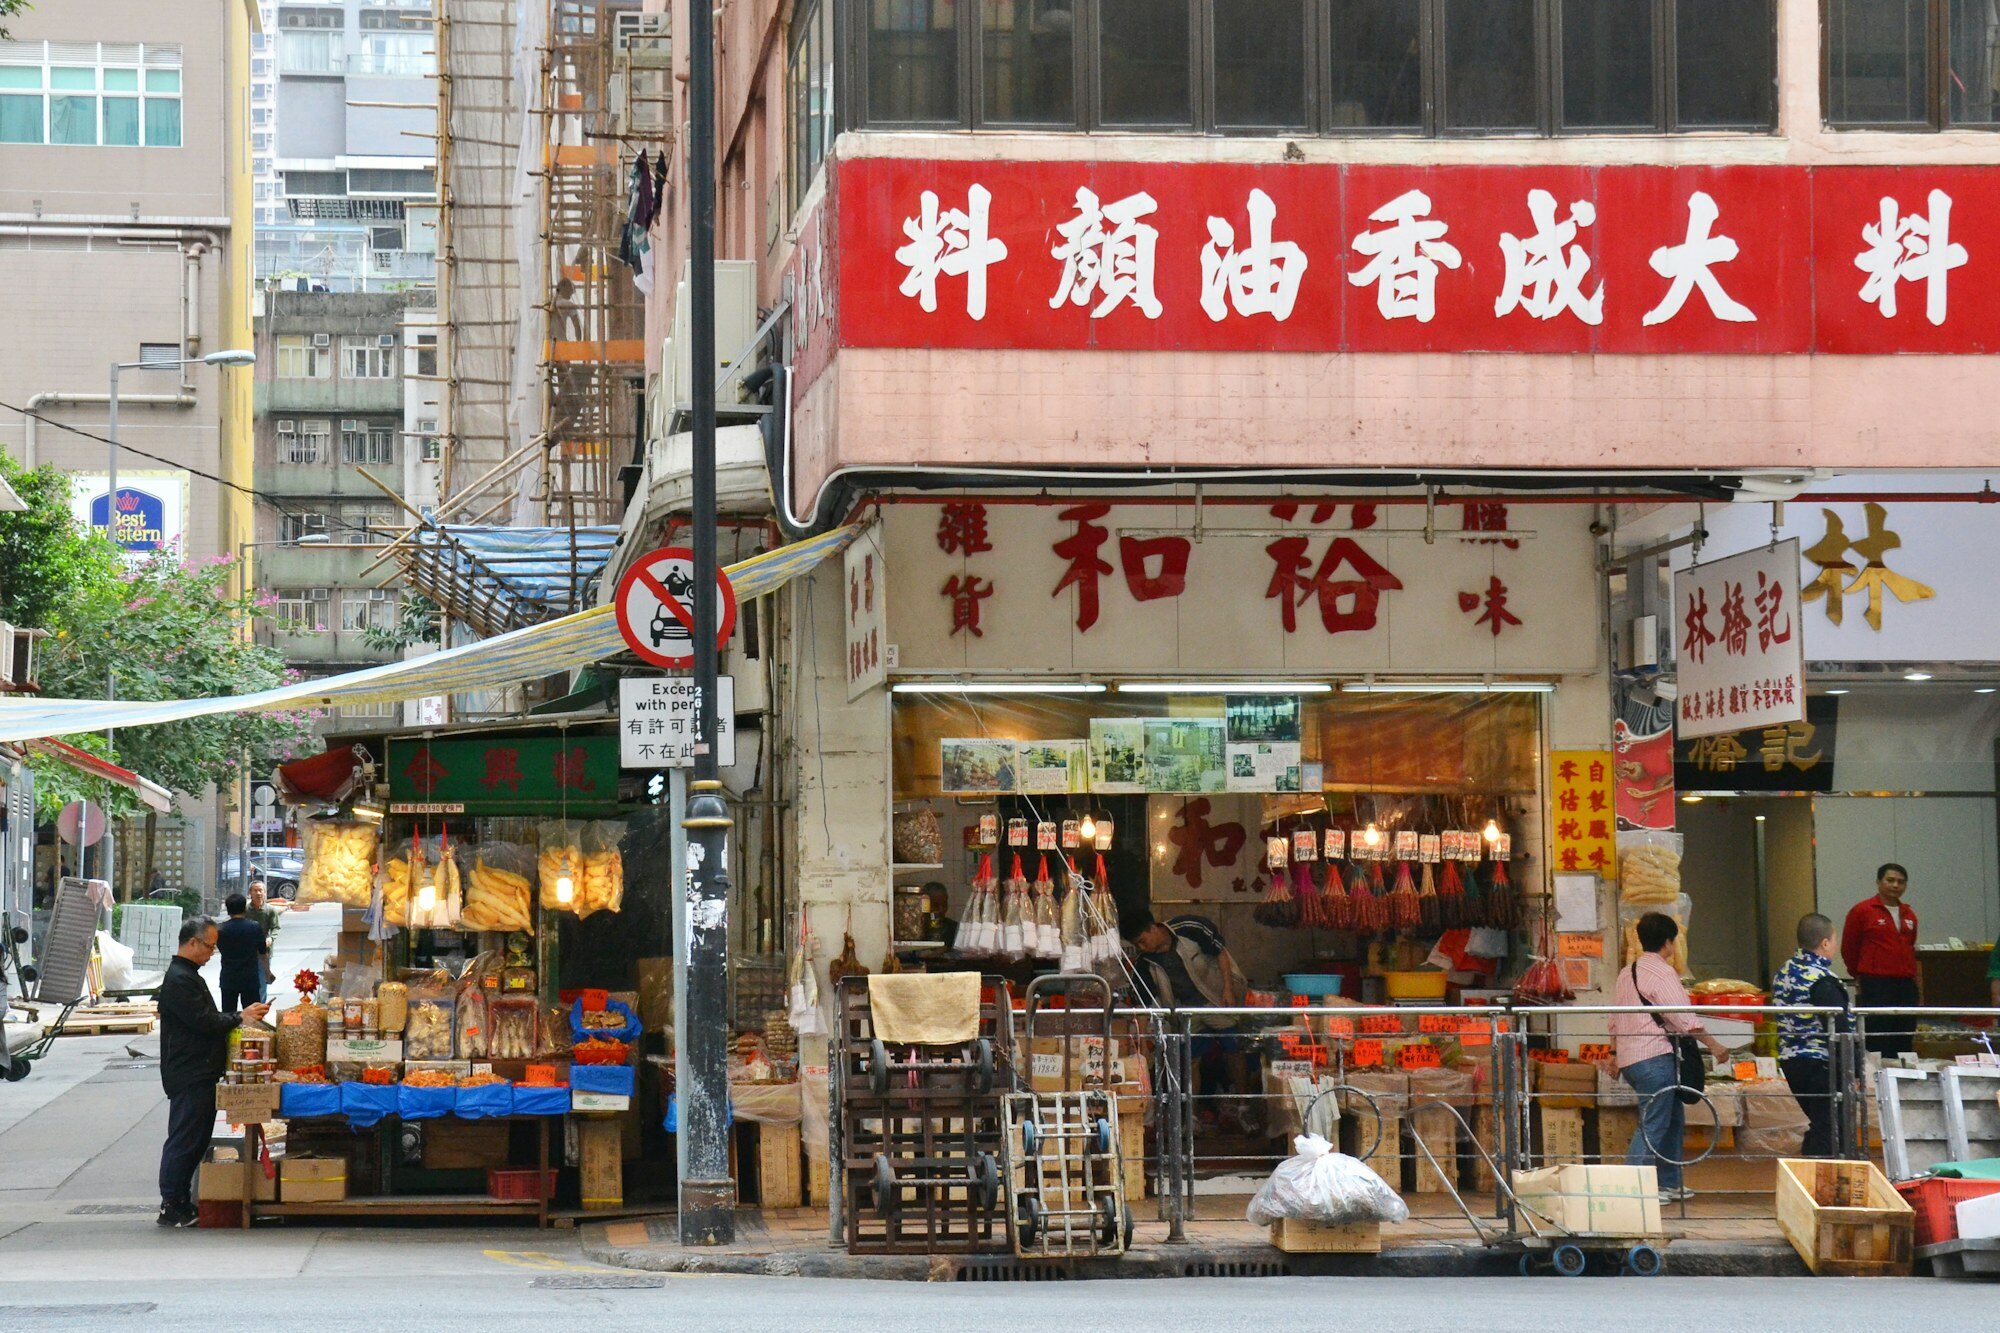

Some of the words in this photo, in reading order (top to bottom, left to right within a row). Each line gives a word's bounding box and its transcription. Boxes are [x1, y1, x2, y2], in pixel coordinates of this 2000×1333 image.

[1854, 188, 1969, 326] 料
[92, 525, 162, 542] Wstern
[1801, 502, 1937, 632] 林
[1683, 569, 1792, 664] 林橋記
[652, 683, 694, 697] Excep
[636, 699, 667, 711] with
[671, 702, 694, 715] per
[627, 718, 727, 735] 有許可者
[638, 743, 695, 760] 不在此
